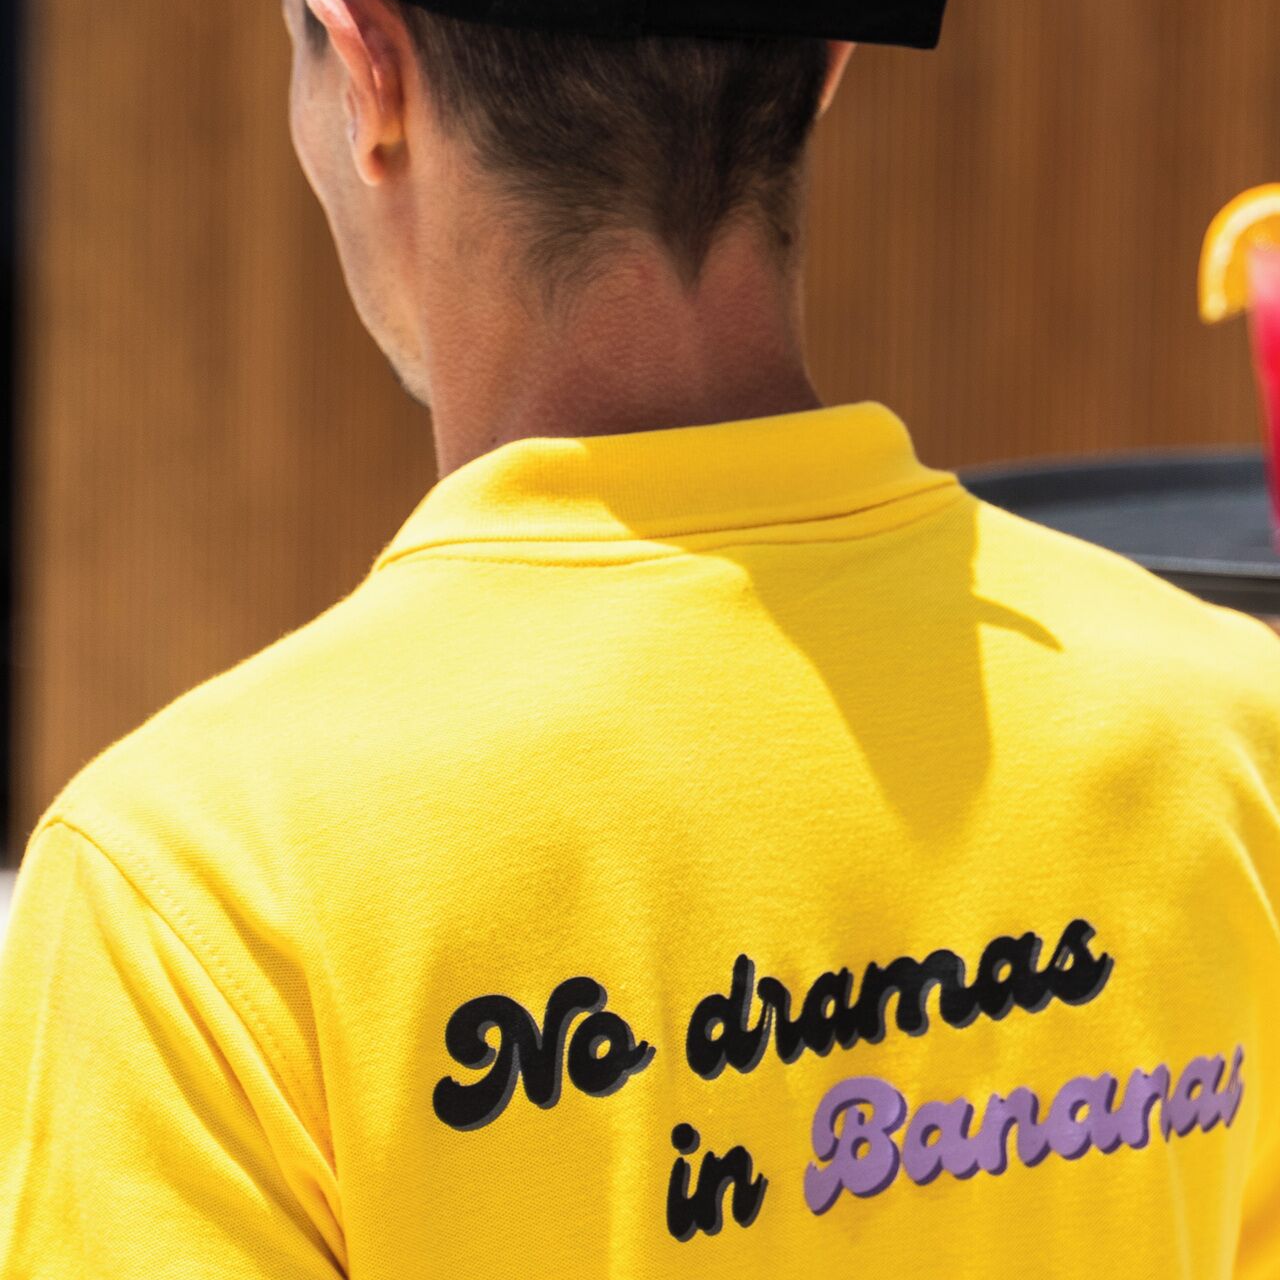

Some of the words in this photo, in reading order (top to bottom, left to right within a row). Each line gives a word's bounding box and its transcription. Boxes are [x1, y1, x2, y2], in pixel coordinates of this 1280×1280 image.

[432, 976, 656, 1132] No
[686, 918, 1115, 1081] dramas
[666, 1122, 768, 1242] in
